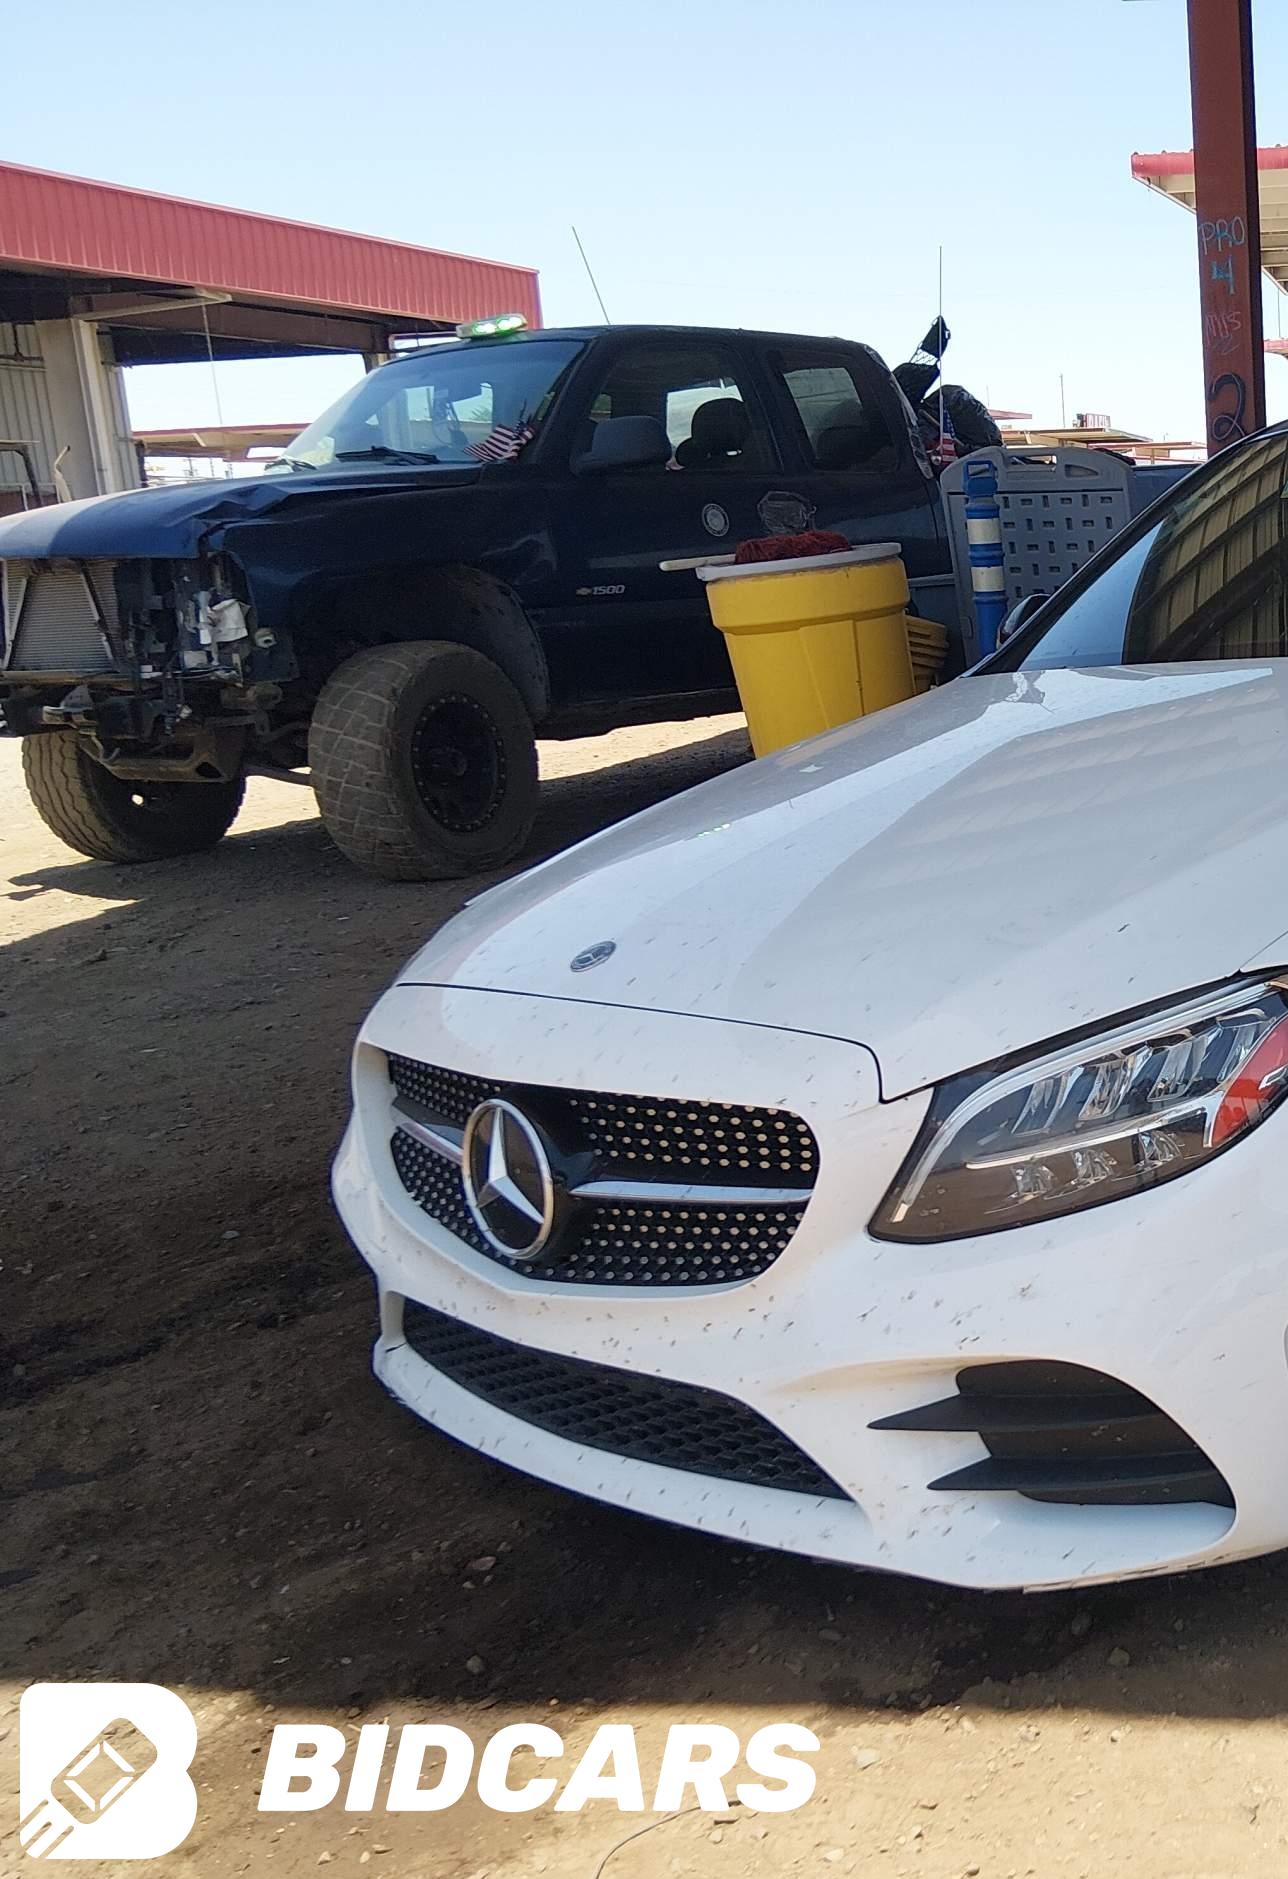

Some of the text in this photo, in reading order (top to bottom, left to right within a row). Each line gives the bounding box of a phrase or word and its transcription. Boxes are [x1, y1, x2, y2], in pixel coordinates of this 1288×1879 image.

[1198, 216, 1245, 255] PRO
[1207, 372, 1246, 441] 2
[592, 584, 626, 596] 1500
